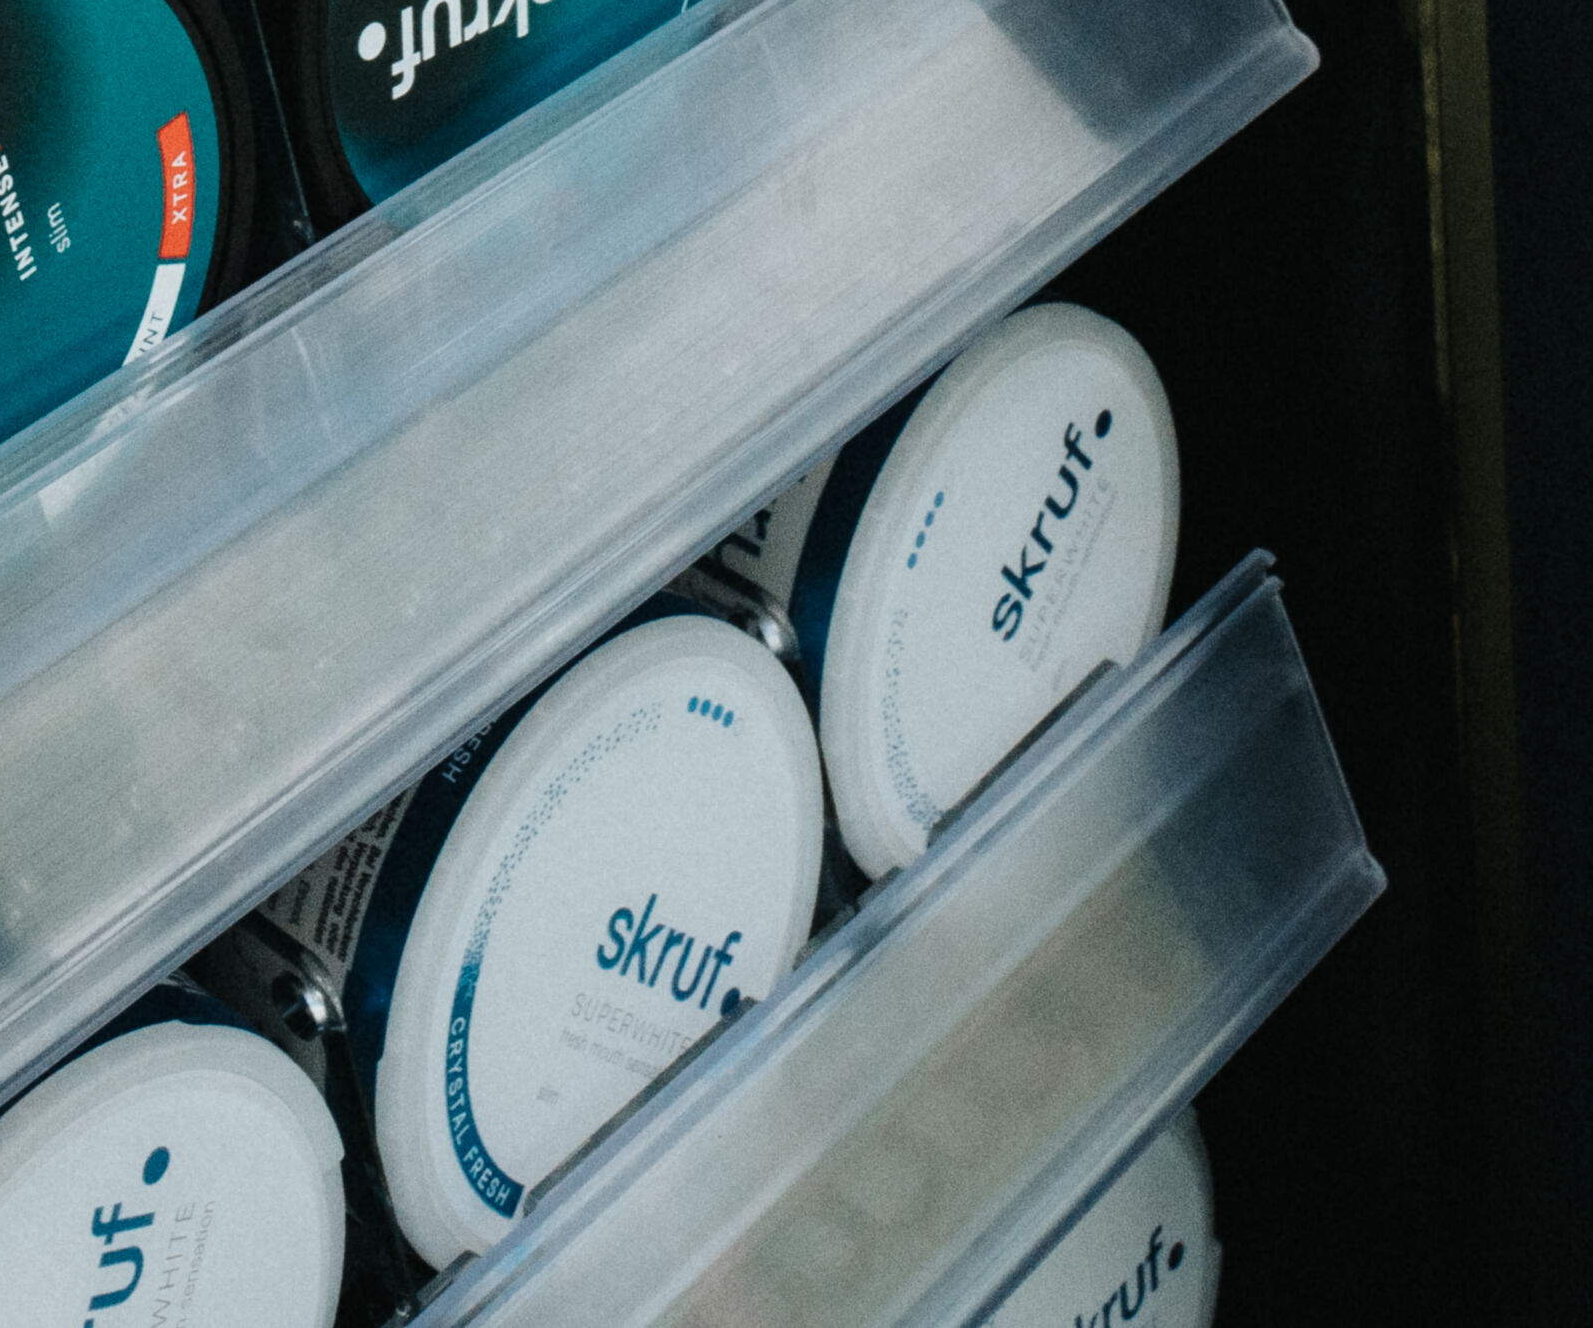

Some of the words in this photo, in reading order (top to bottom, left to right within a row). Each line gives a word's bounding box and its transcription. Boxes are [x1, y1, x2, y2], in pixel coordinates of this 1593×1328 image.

[171, 150, 188, 225] XTRA
[46, 202, 73, 254] slim
[448, 1016, 470, 1147] CRYSTAL
[463, 1147, 510, 1206] FRESH
